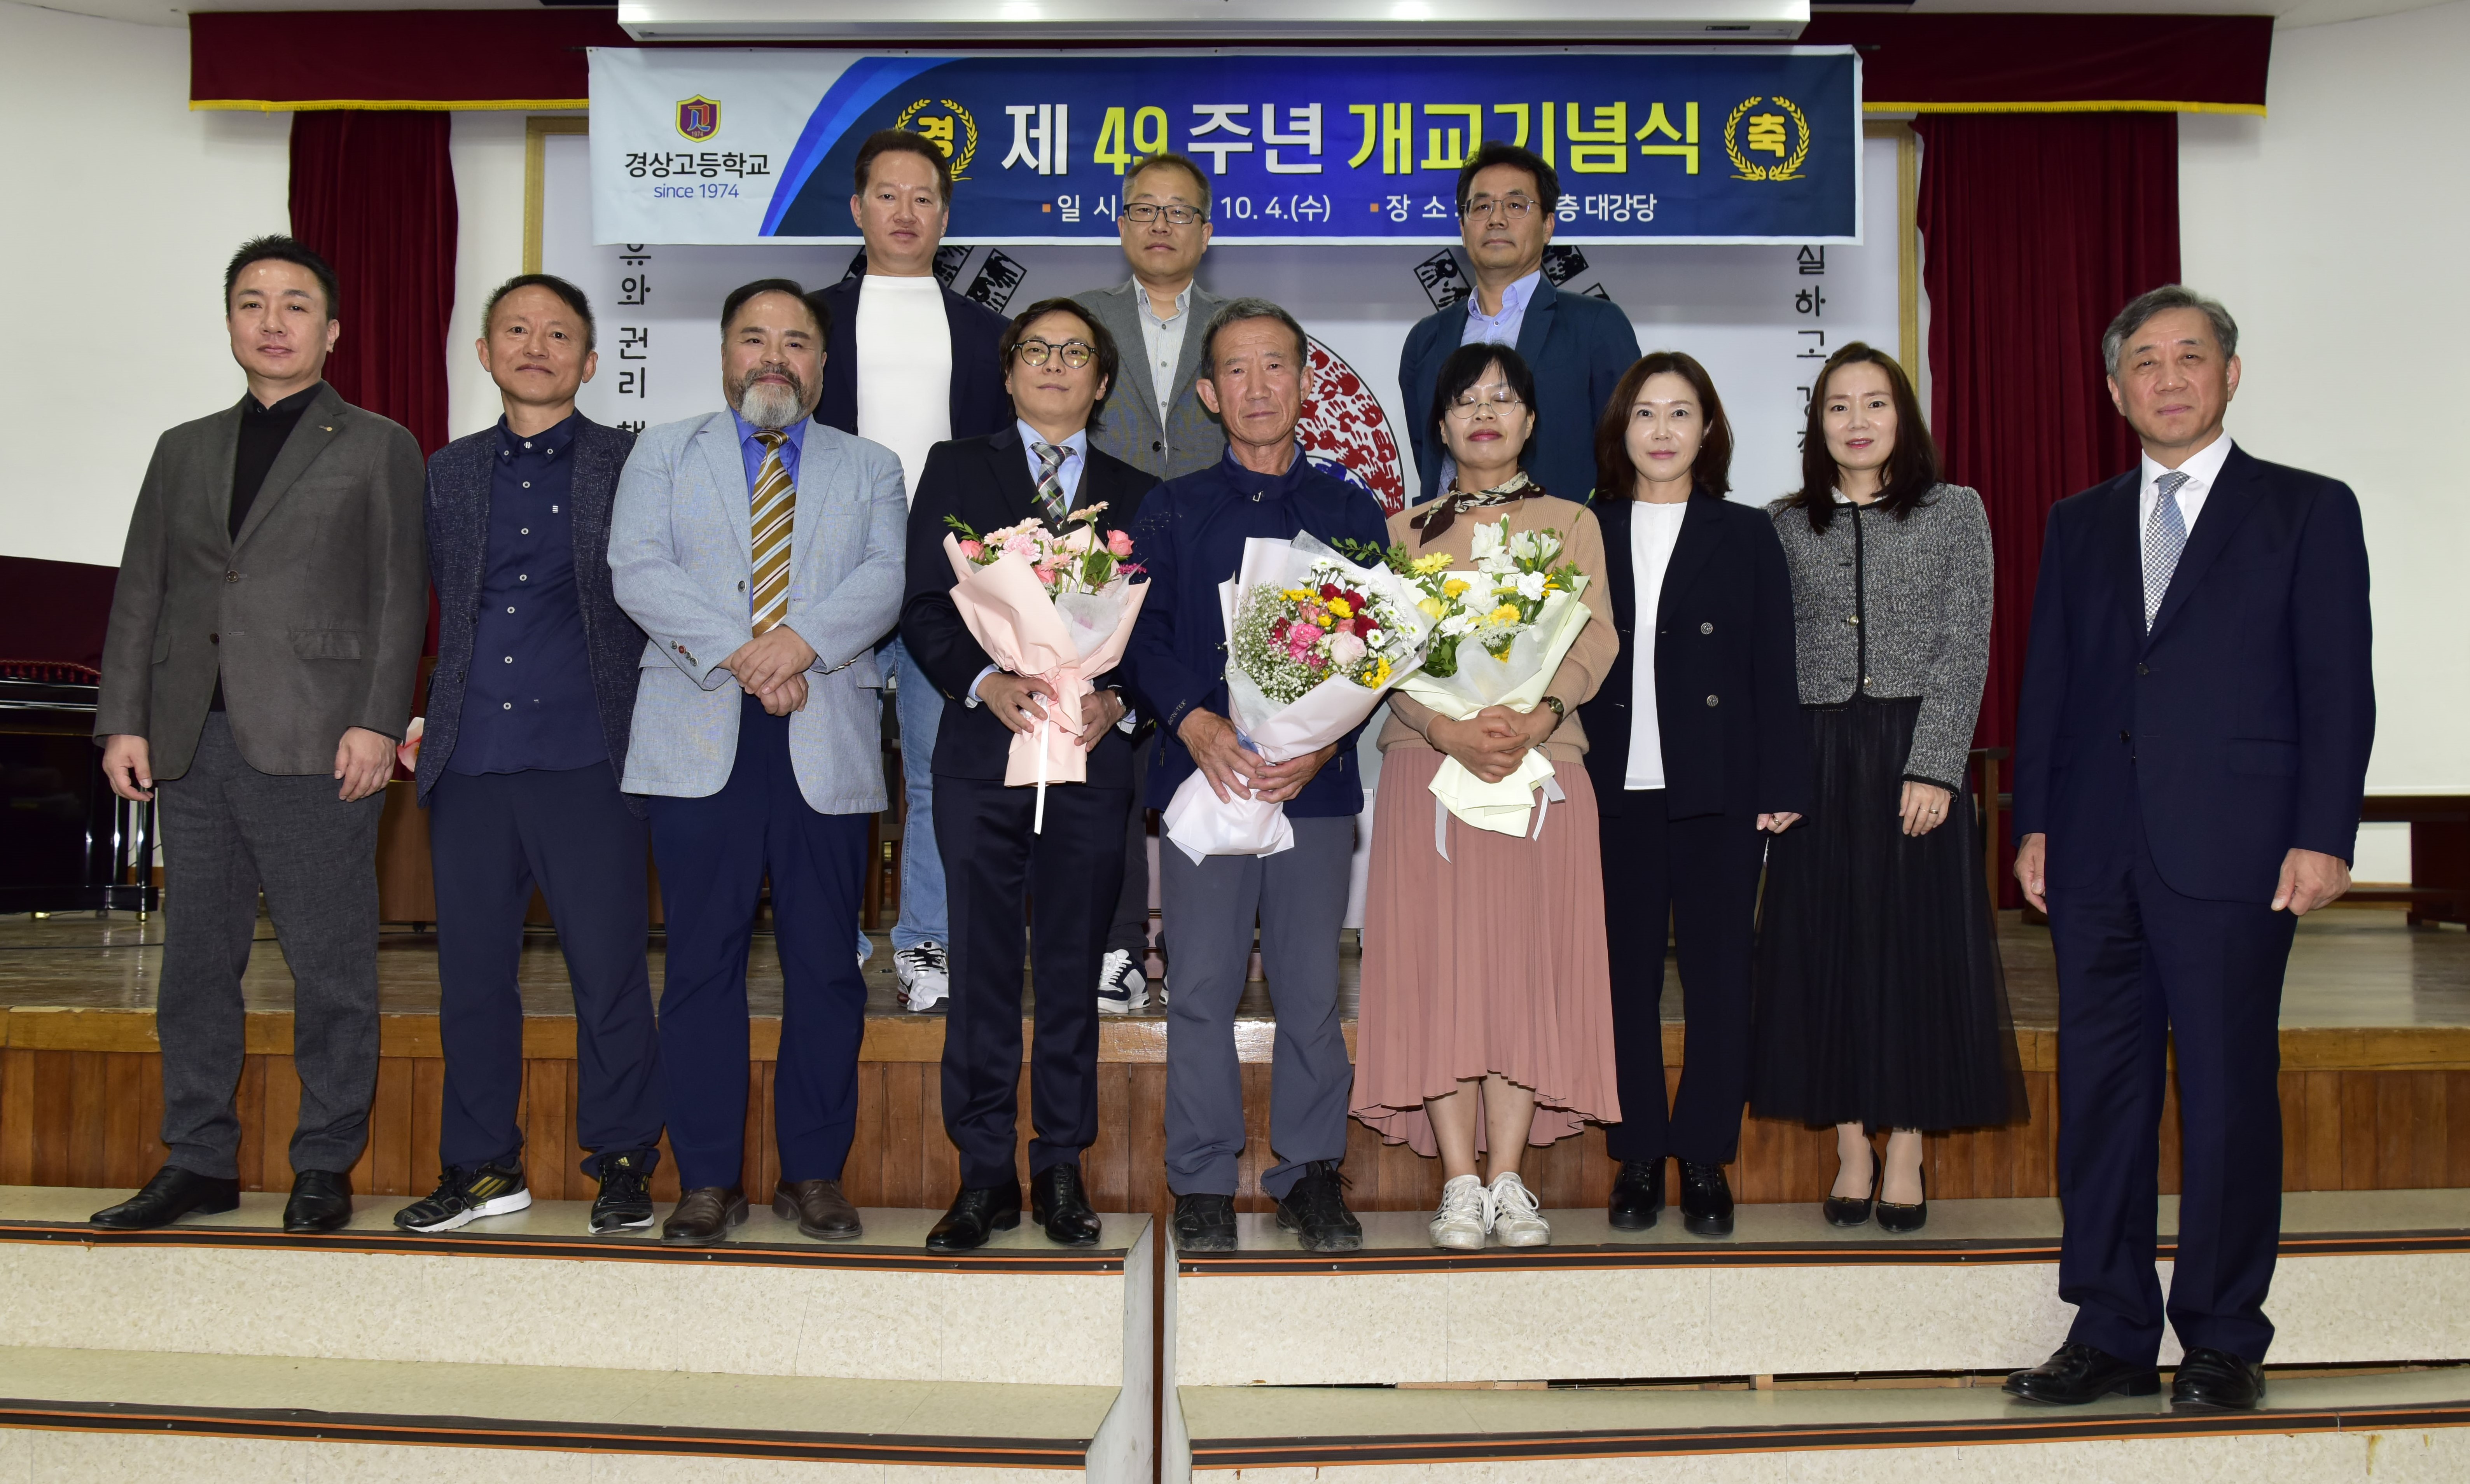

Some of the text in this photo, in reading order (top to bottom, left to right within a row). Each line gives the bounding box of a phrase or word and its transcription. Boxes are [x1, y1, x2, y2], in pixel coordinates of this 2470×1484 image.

[918, 116, 953, 157] 경
[1001, 102, 1698, 175] 제 49 주년 개교기념식
[1748, 113, 1786, 157] 축
[625, 152, 770, 178] 경상고등학교
[654, 183, 739, 198] since 1974
[1585, 194, 1657, 222] 대강당
[619, 327, 648, 399] 권리
[1168, 700, 1186, 725] GORE-TEX
